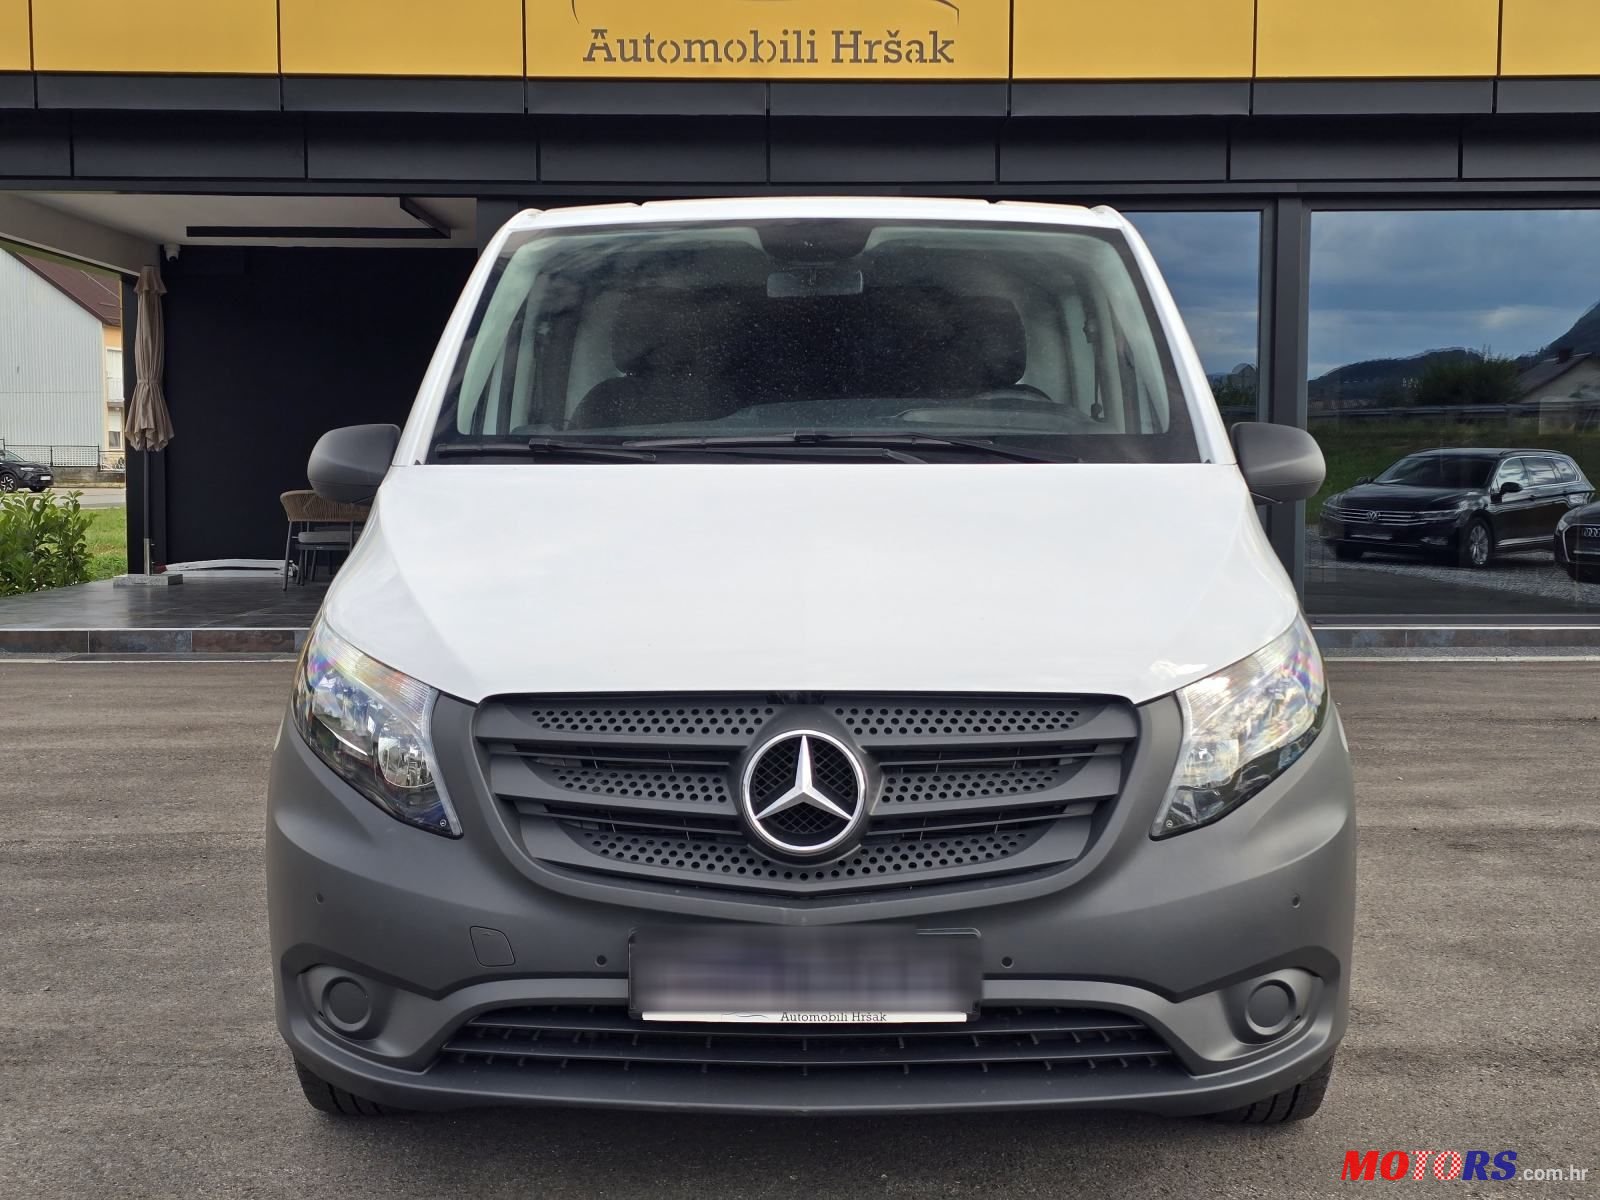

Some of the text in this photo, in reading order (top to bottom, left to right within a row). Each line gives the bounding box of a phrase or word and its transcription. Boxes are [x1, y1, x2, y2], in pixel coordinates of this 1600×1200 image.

[583, 29, 954, 63] Automobili Hršak
[780, 1011, 848, 1022] Automobili
